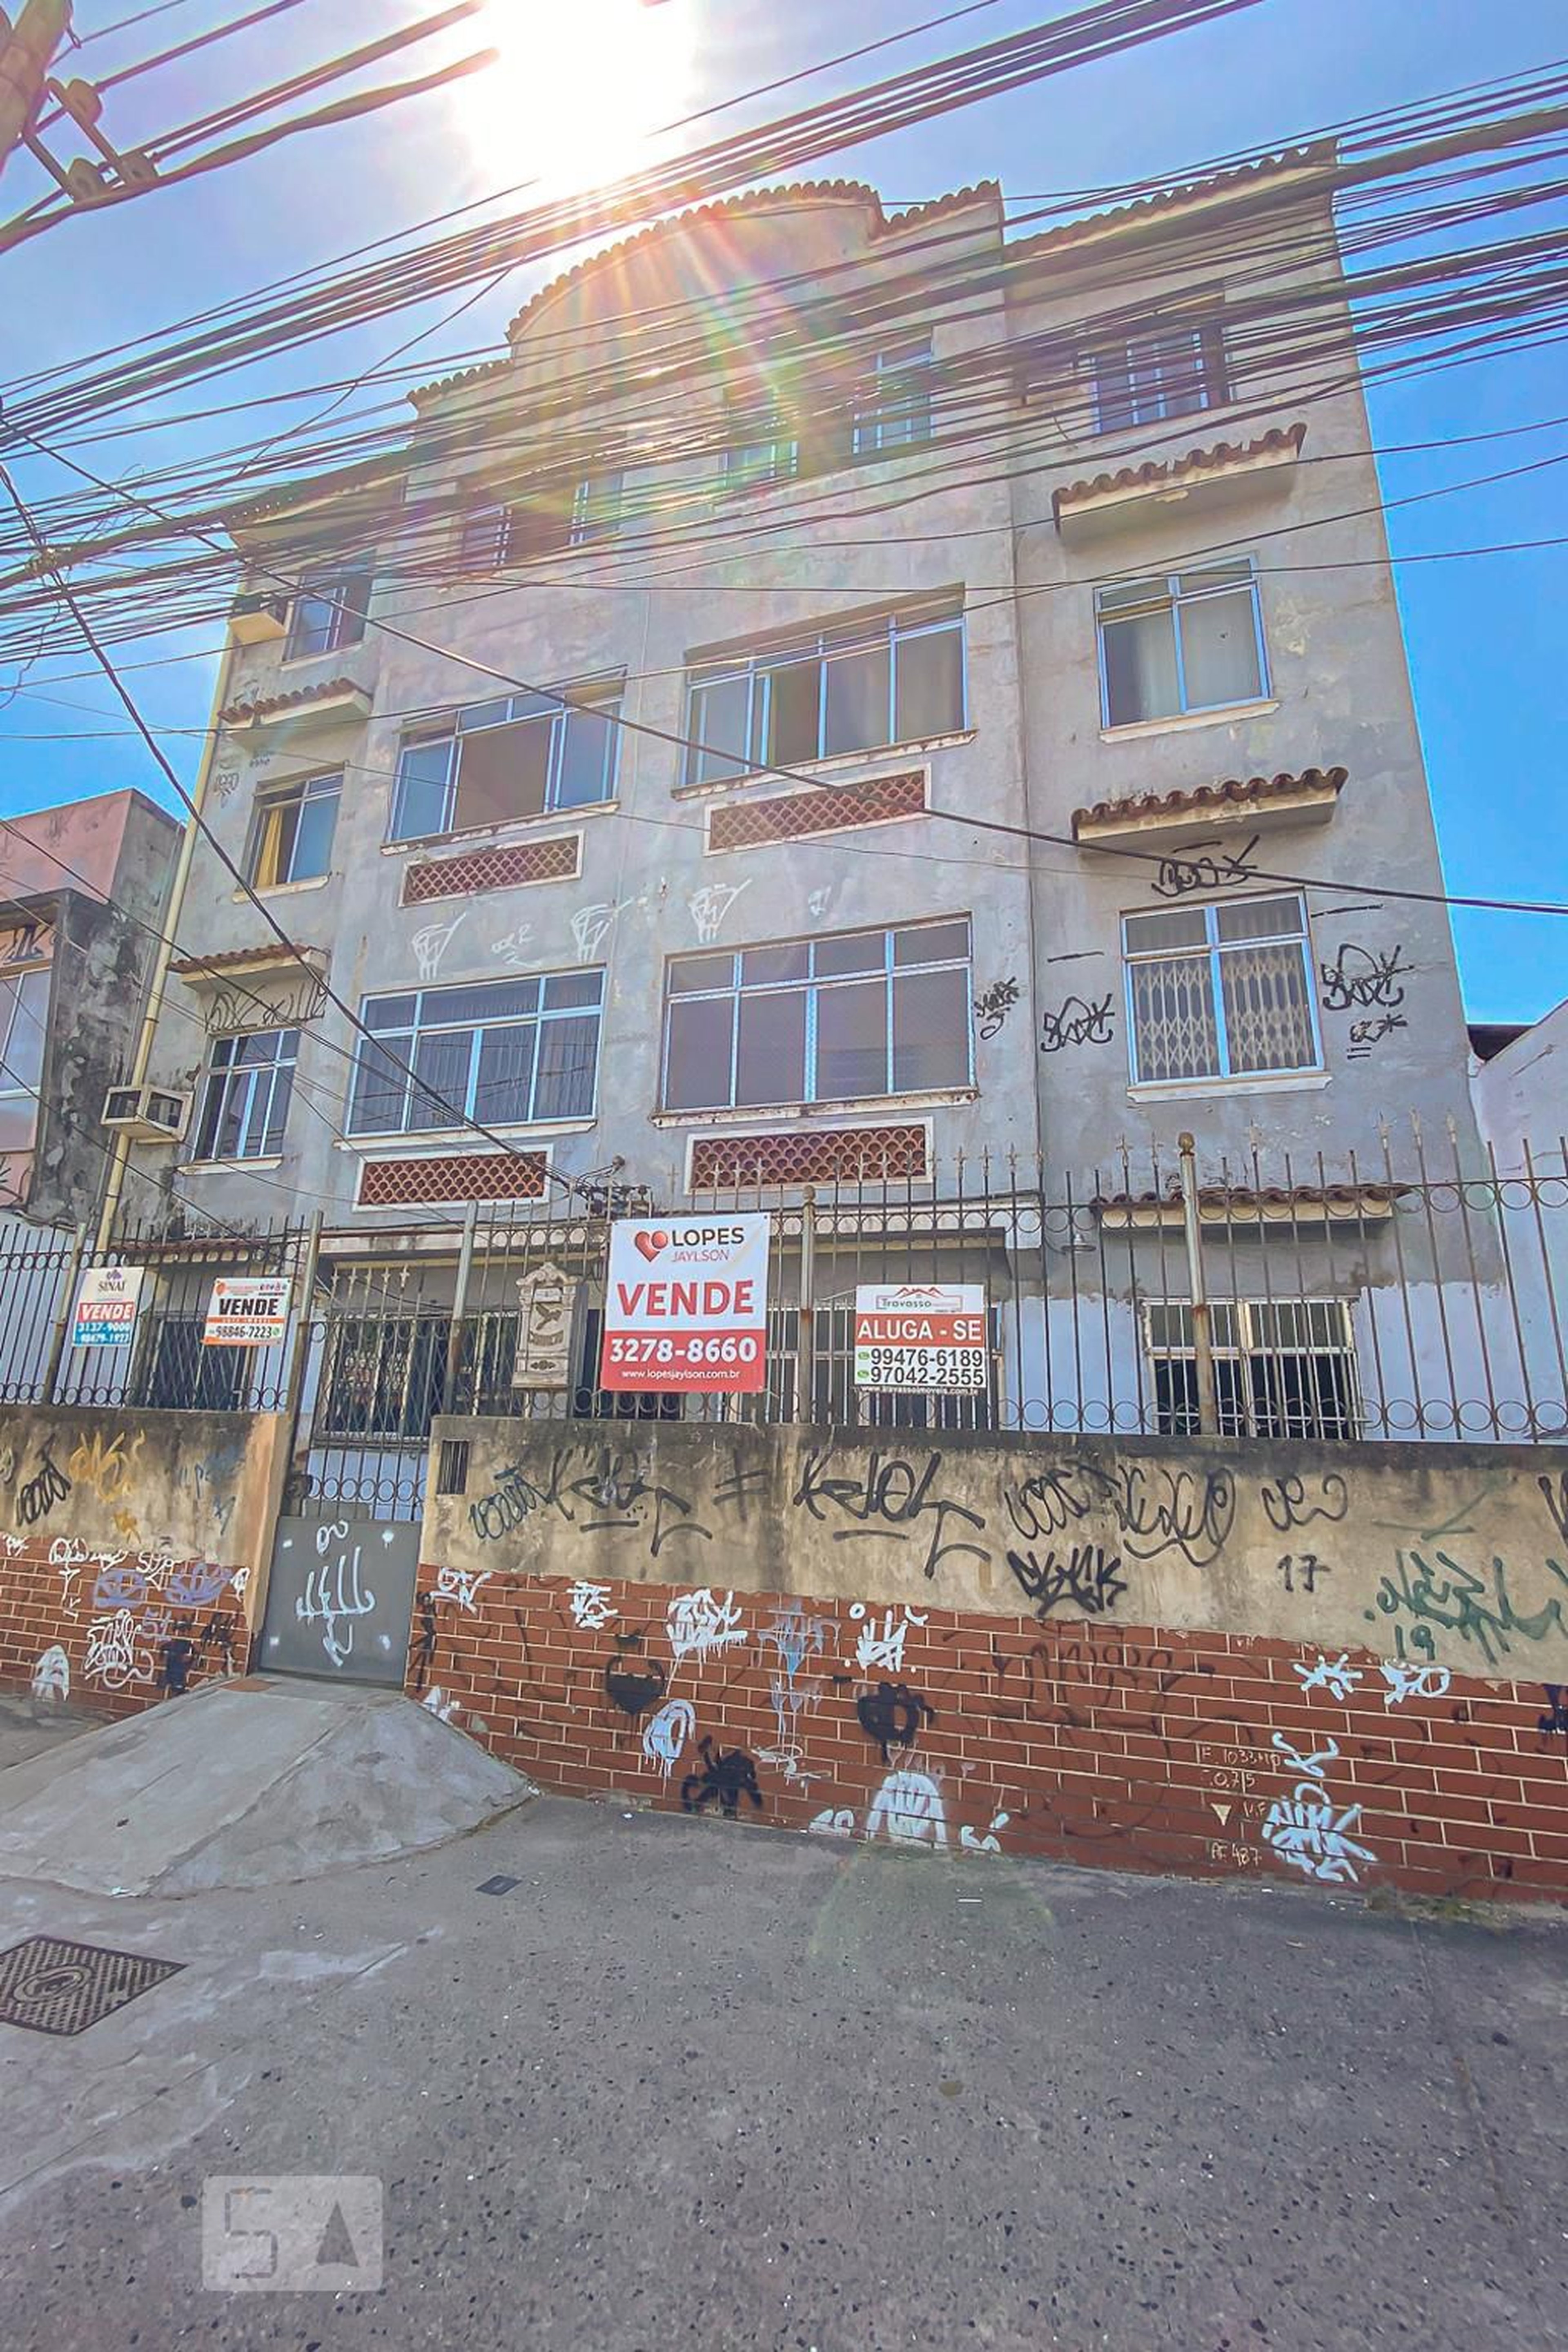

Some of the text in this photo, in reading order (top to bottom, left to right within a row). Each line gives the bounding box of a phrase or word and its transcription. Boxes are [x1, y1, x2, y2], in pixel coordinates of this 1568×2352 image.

[672, 1227, 744, 1247] LOPES
[671, 1250, 730, 1262] JAYLSON
[219, 1298, 279, 1316] VENDE
[617, 1280, 754, 1316] VENDE
[881, 1298, 932, 1307] Travasso
[81, 1304, 134, 1321] VENDE
[858, 1319, 933, 1340] ALUGA
[953, 1319, 981, 1340] SE
[610, 1336, 757, 1363] 3278-8660
[871, 1348, 983, 1367] 99476-6189
[621, 1369, 740, 1380] www.lopesjaylson.com.br
[871, 1366, 984, 1385] 97042-2555
